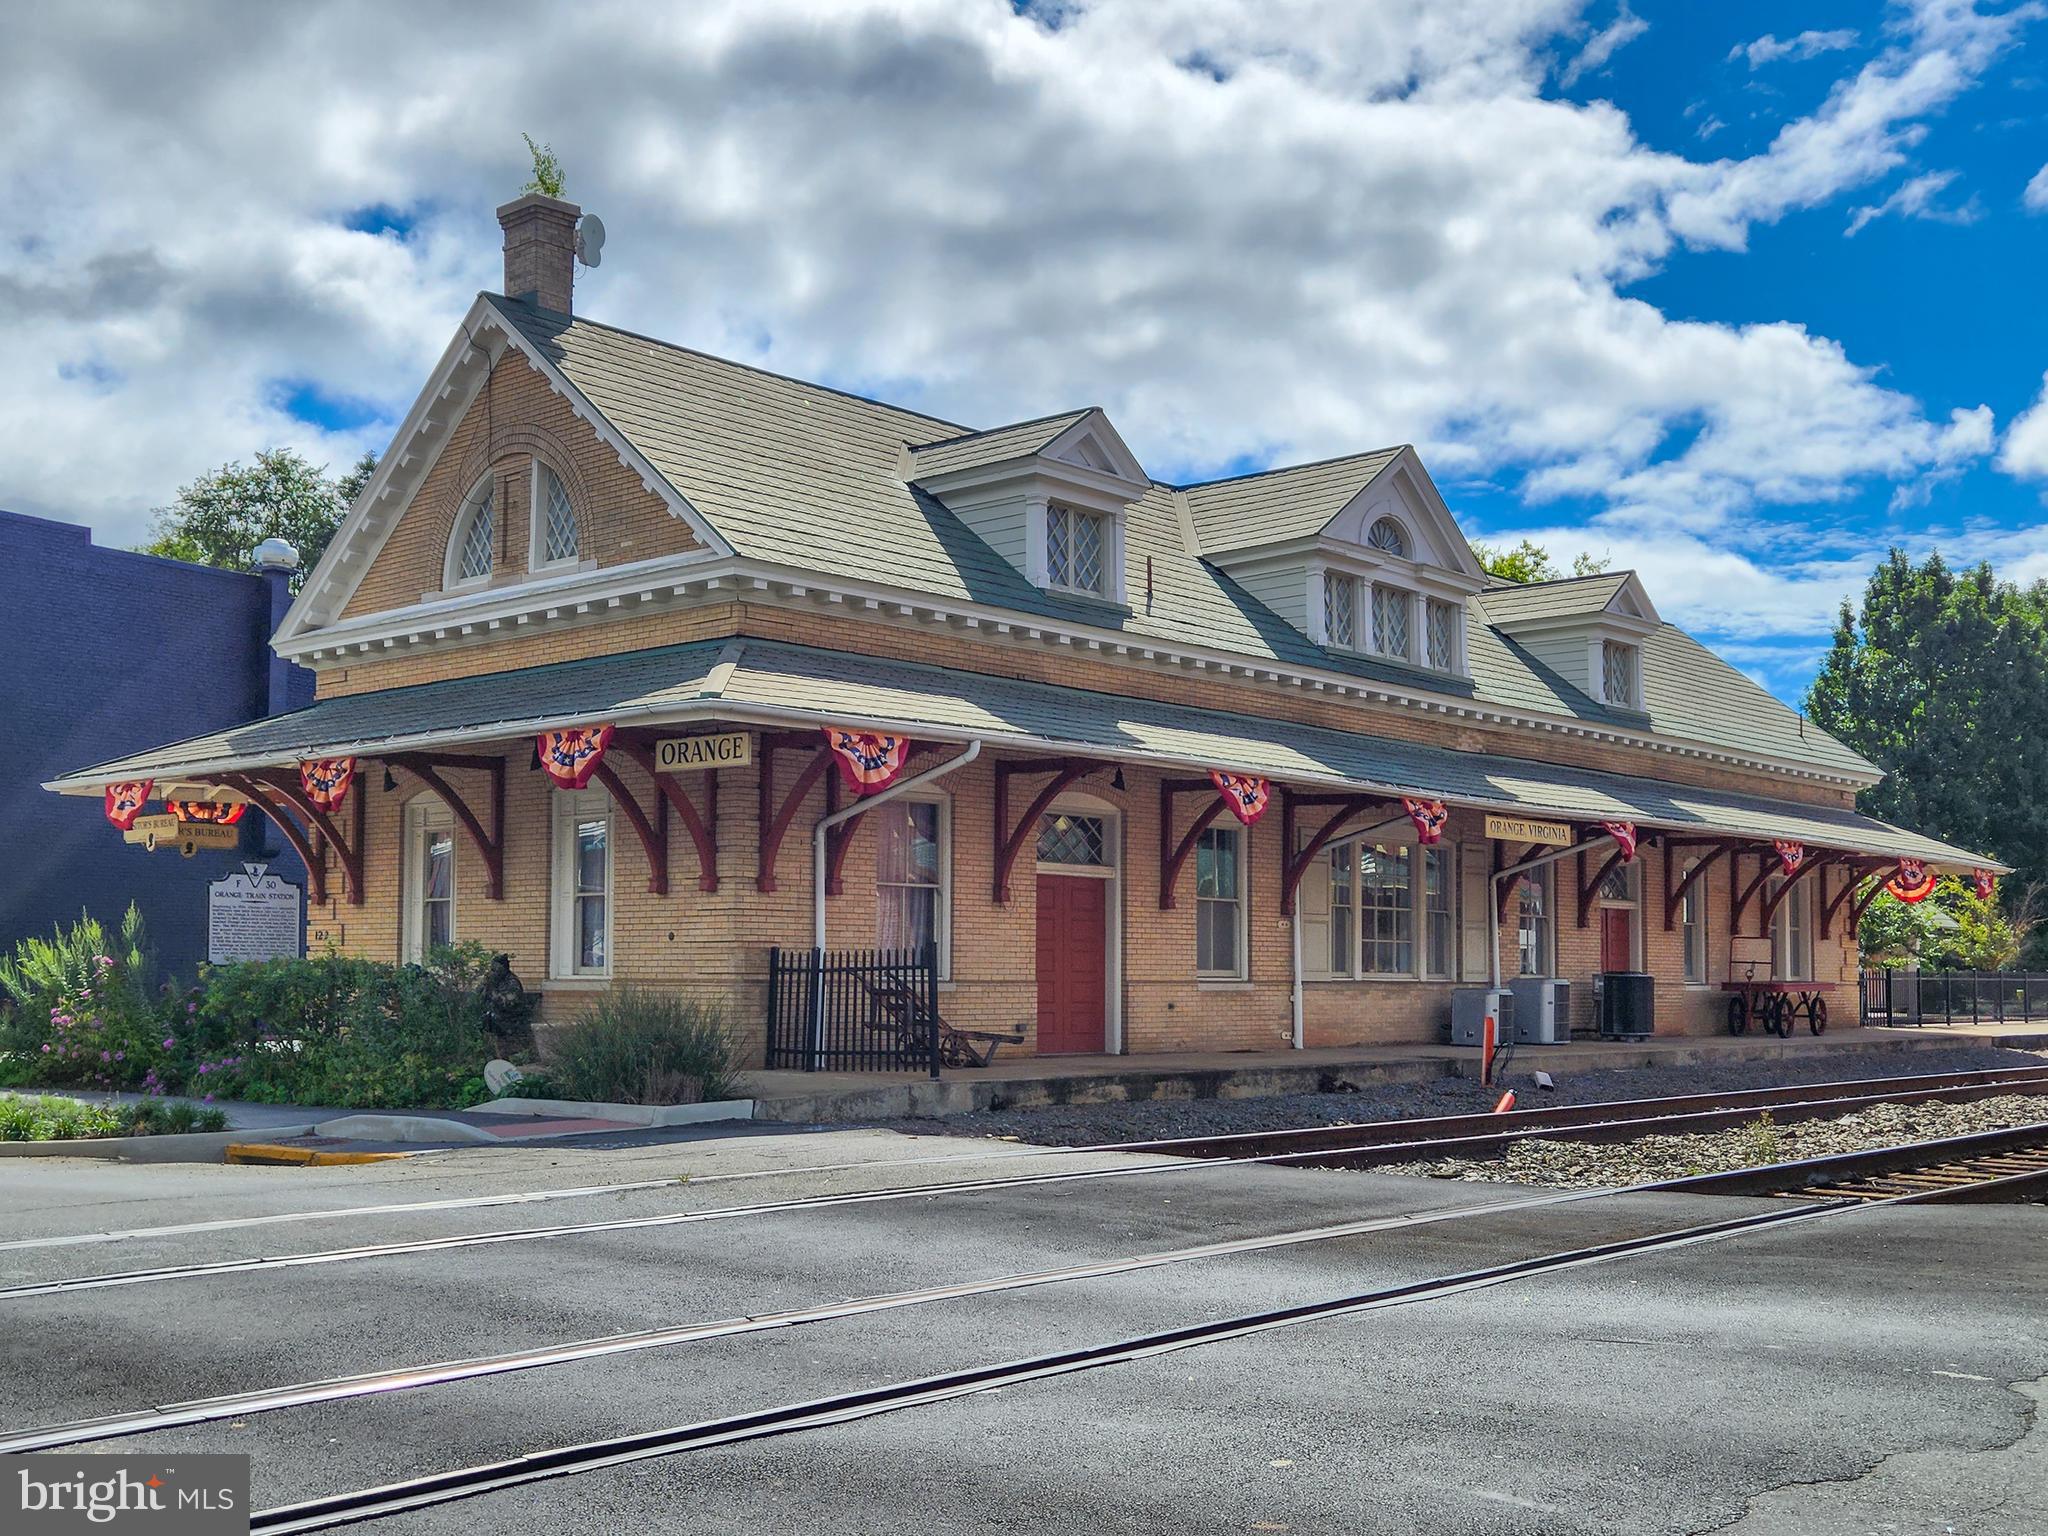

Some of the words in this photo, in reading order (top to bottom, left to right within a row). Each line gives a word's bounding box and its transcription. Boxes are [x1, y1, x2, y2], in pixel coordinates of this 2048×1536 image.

[661, 737, 743, 765] ORANGE
[194, 828, 233, 838] BUREAU
[1529, 824, 1567, 841] VIRGINIA
[236, 880, 241, 888] F
[266, 881, 276, 889] 30
